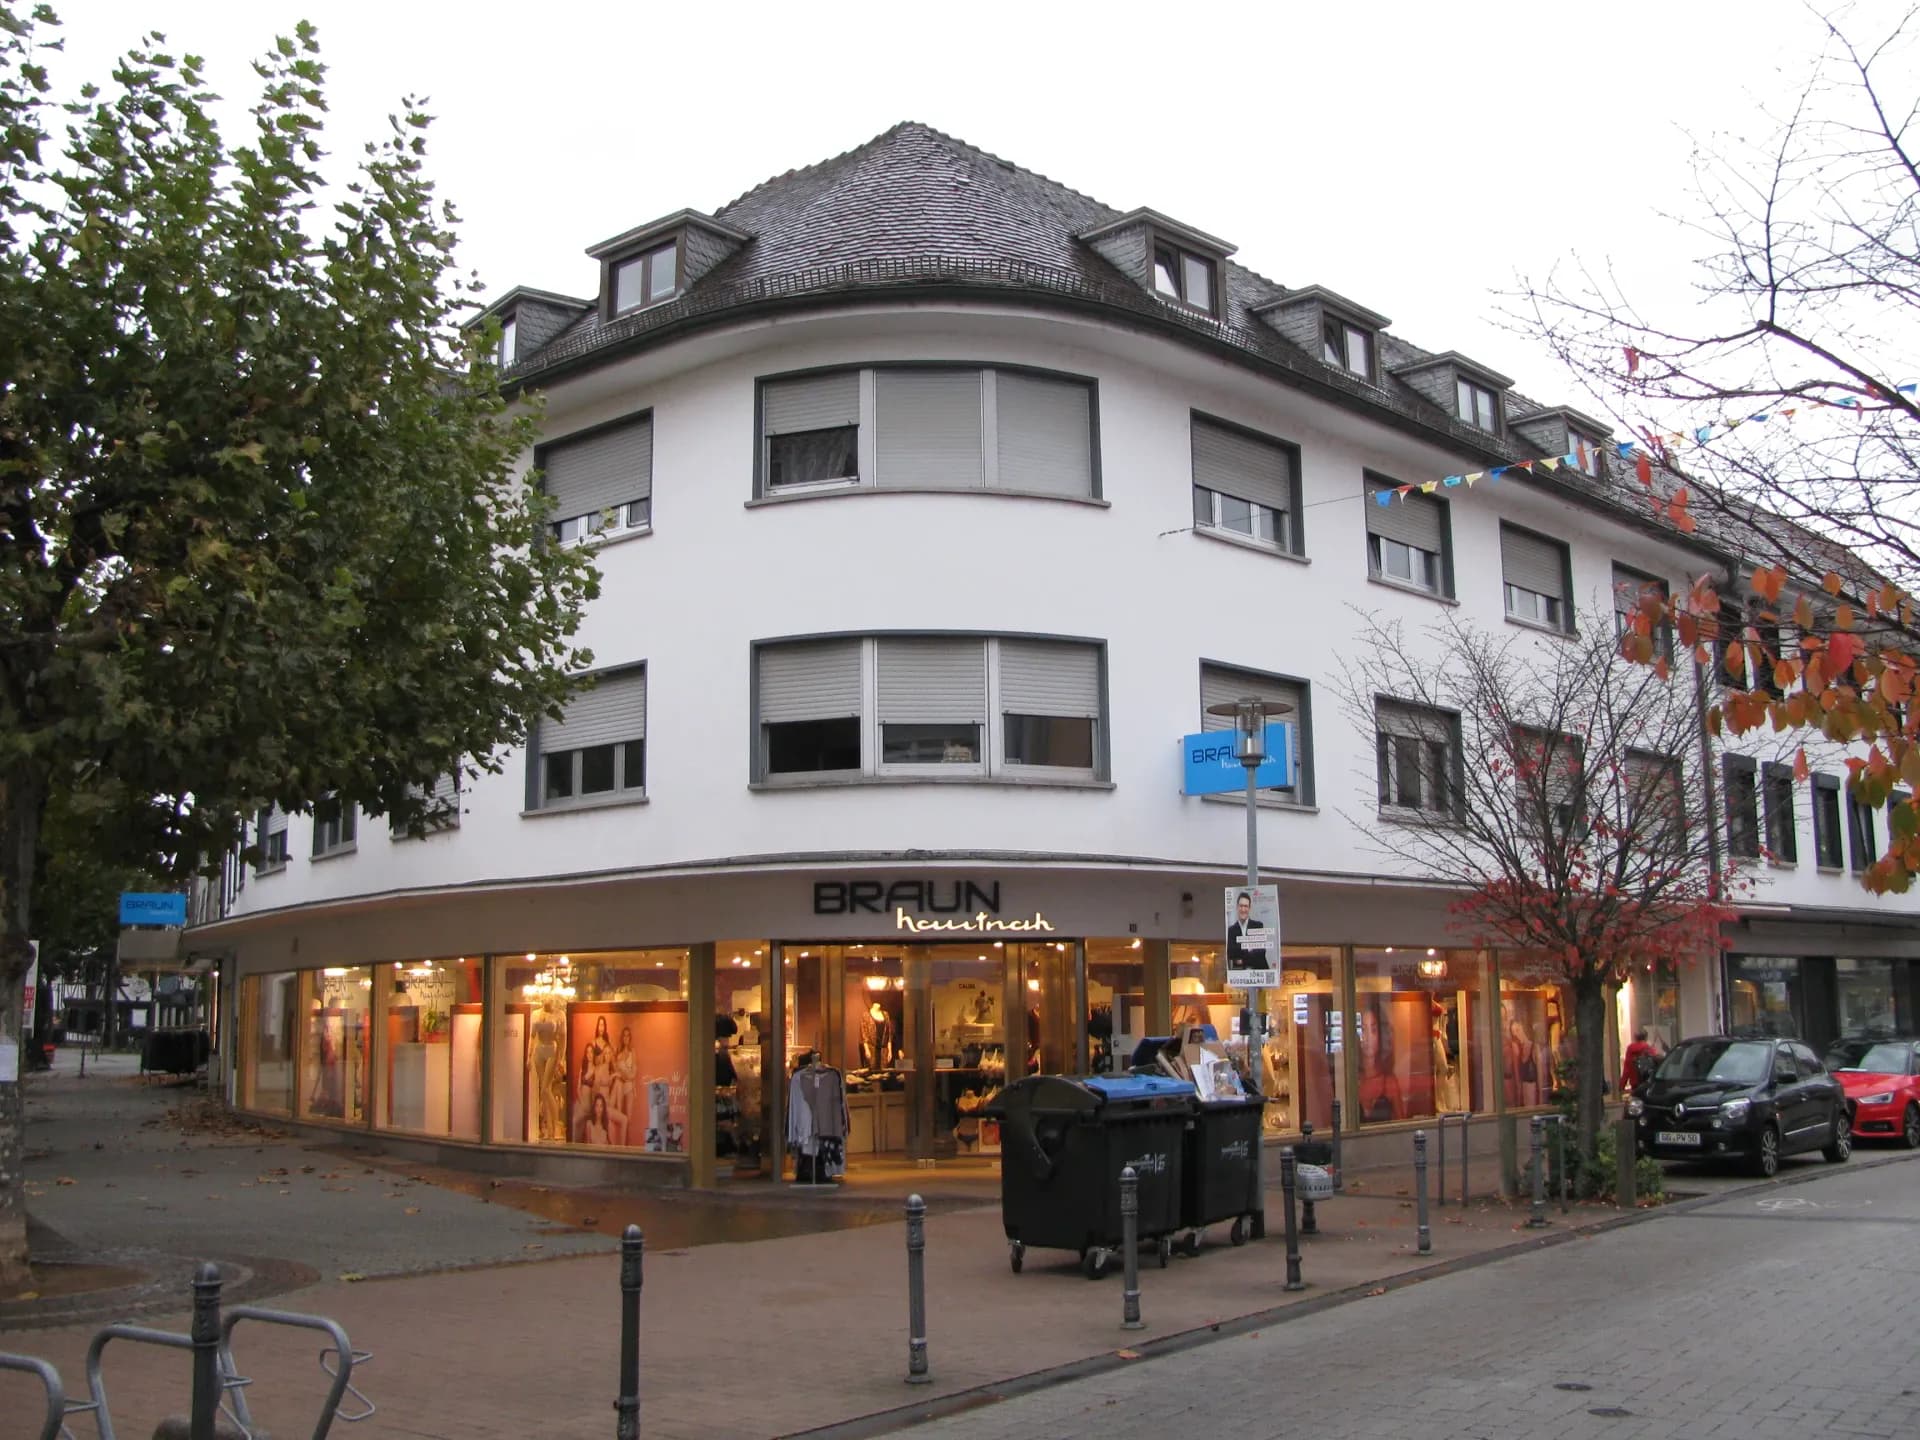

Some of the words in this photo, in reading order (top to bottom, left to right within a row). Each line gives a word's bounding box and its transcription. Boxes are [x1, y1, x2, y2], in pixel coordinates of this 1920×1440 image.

[126, 899, 174, 911] BRAUN
[814, 880, 1000, 914] BRAUN
[896, 907, 1055, 933] hautnah
